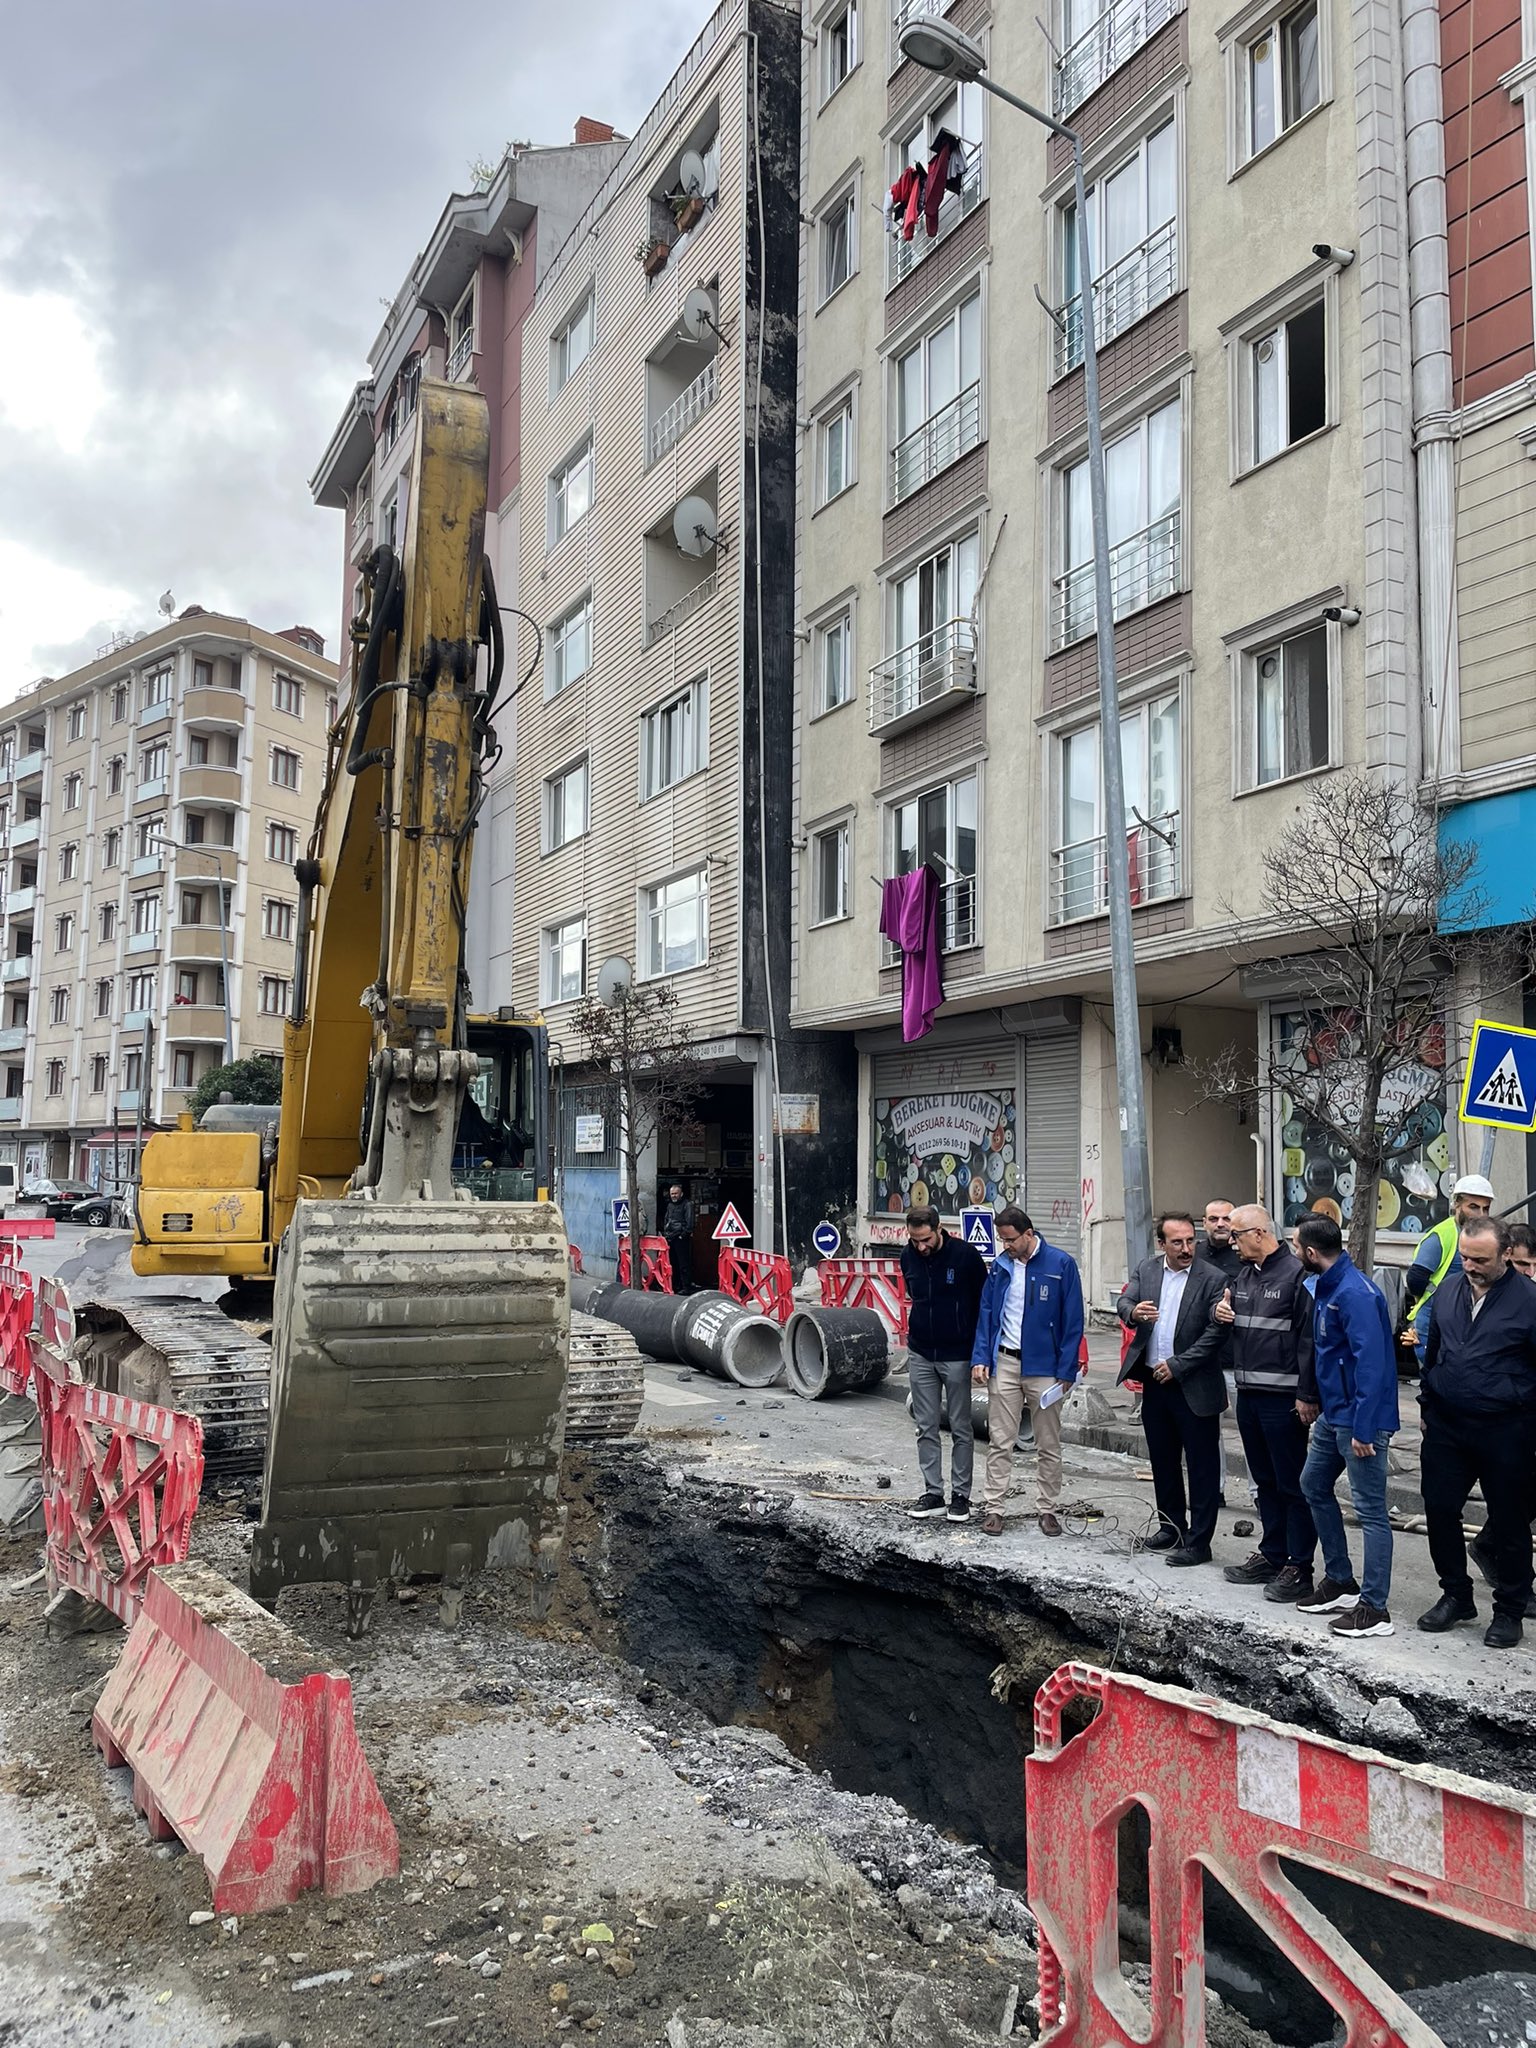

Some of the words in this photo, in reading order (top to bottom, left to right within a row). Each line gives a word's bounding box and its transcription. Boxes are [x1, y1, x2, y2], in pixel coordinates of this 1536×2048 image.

[907, 1116, 945, 1140] AKSESUAR
[947, 1116, 953, 1128] &
[918, 1140, 932, 1152] 0212
[932, 1138, 942, 1148] 269
[943, 1137, 950, 1146] 56
[951, 1139, 967, 1151] 10-11
[1085, 1144, 1100, 1160] 35
